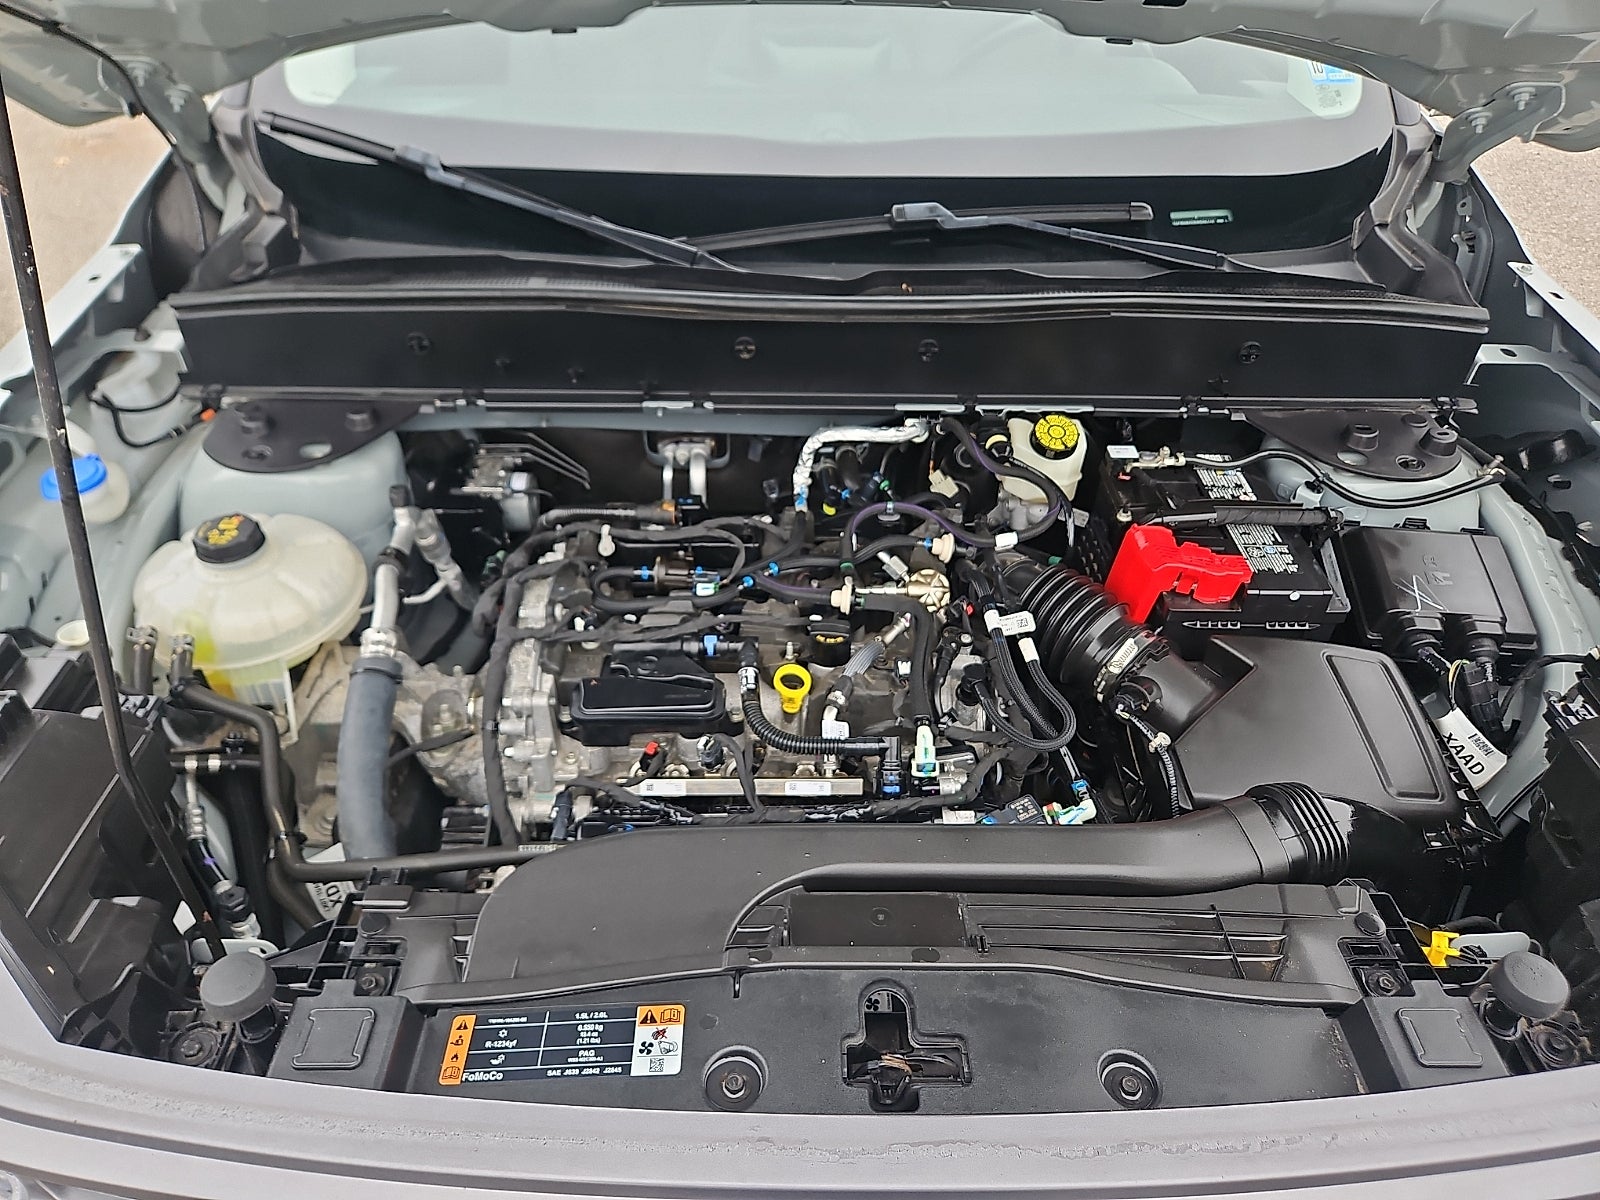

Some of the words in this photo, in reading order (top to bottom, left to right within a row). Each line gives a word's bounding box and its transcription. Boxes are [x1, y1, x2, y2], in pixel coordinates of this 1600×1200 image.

[1442, 732, 1485, 775] XAAD
[578, 1049, 595, 1057] PAG
[462, 1071, 504, 1081] FoMoCo
